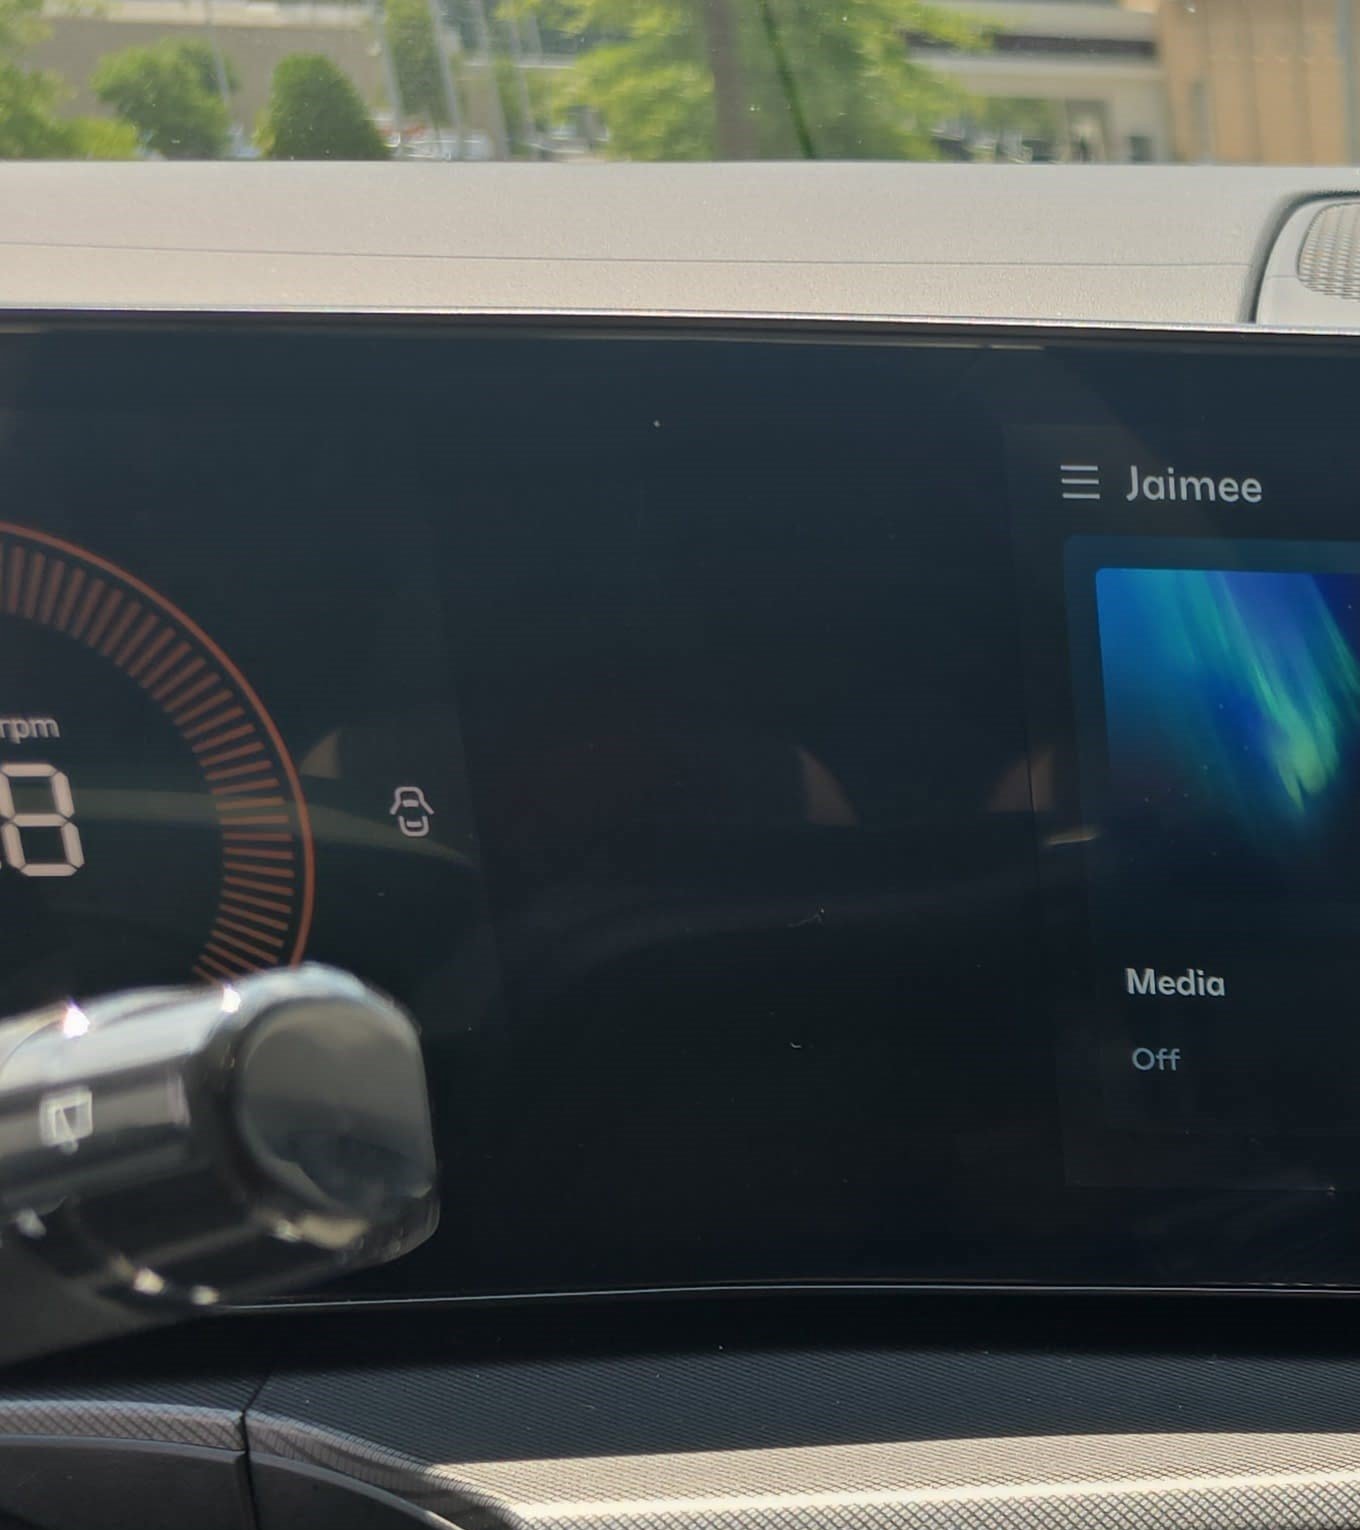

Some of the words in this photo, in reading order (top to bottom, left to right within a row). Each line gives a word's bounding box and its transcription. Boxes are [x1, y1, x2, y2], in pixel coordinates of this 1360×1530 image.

[1126, 464, 1264, 504] Jaimee
[1125, 966, 1226, 1000] Media
[1131, 1046, 1182, 1073] Off
